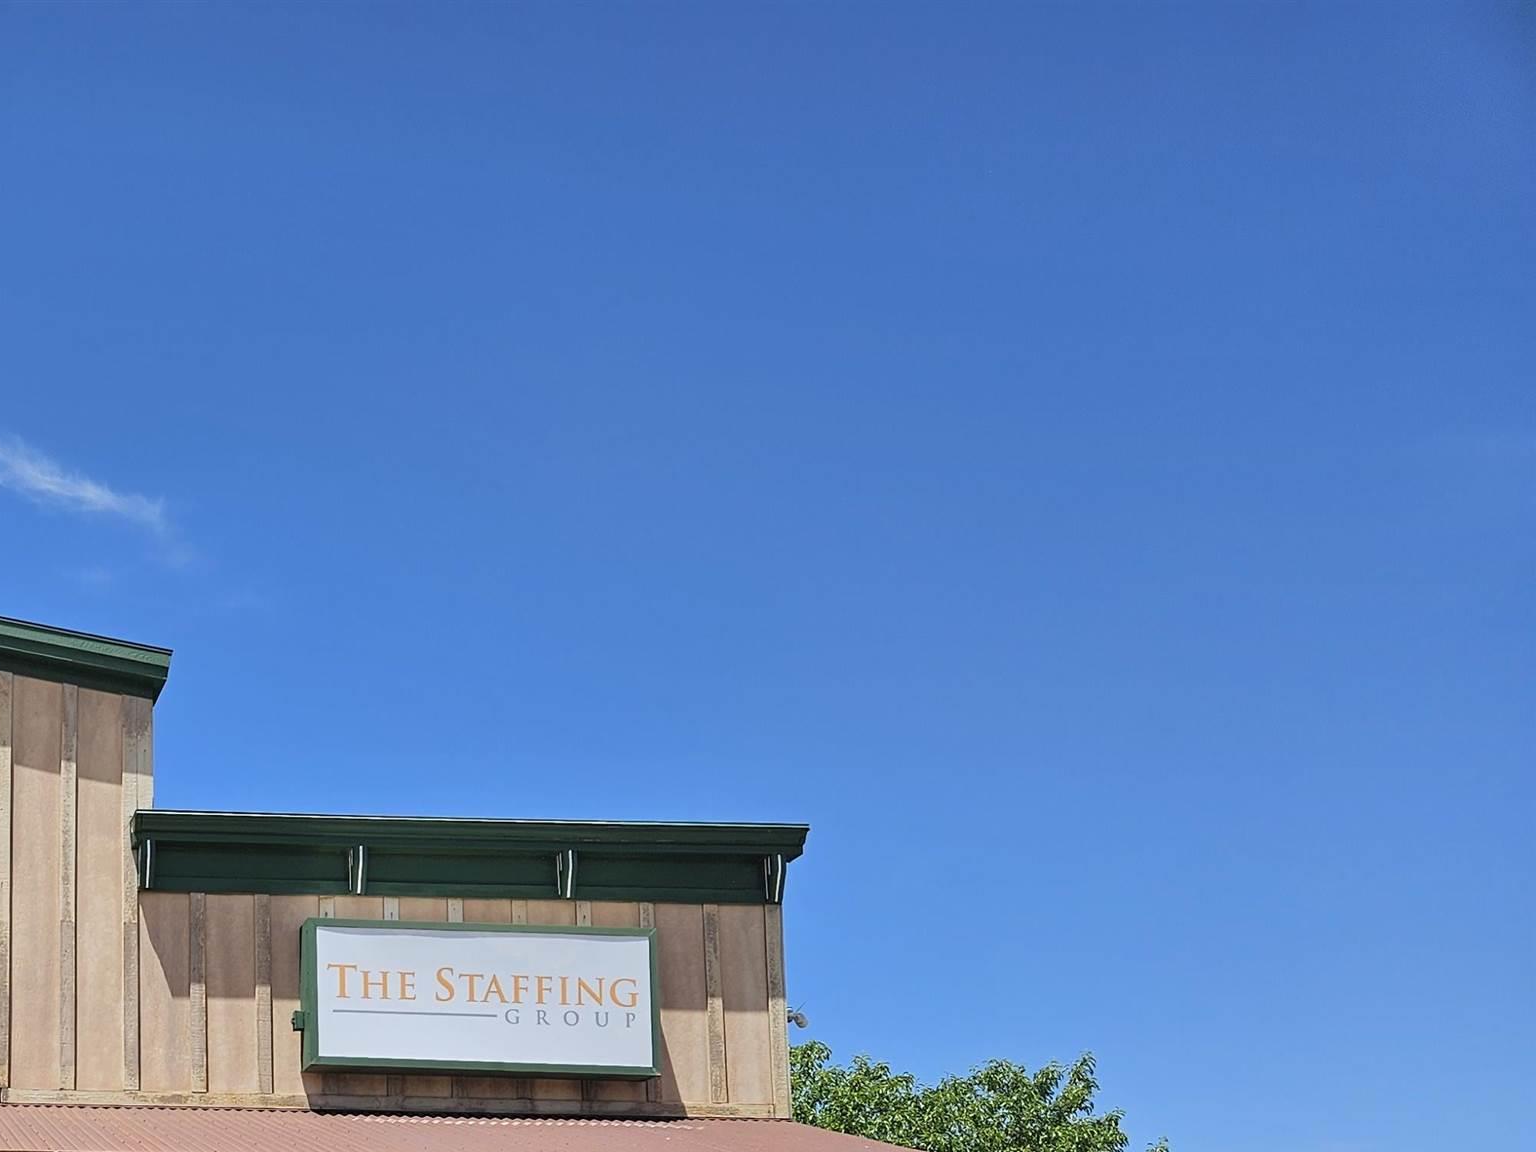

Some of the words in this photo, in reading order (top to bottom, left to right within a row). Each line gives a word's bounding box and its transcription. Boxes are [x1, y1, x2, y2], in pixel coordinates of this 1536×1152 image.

[327, 963, 417, 1001] THE
[435, 967, 639, 1008] STAFFING
[504, 1008, 637, 1028] GROUP
